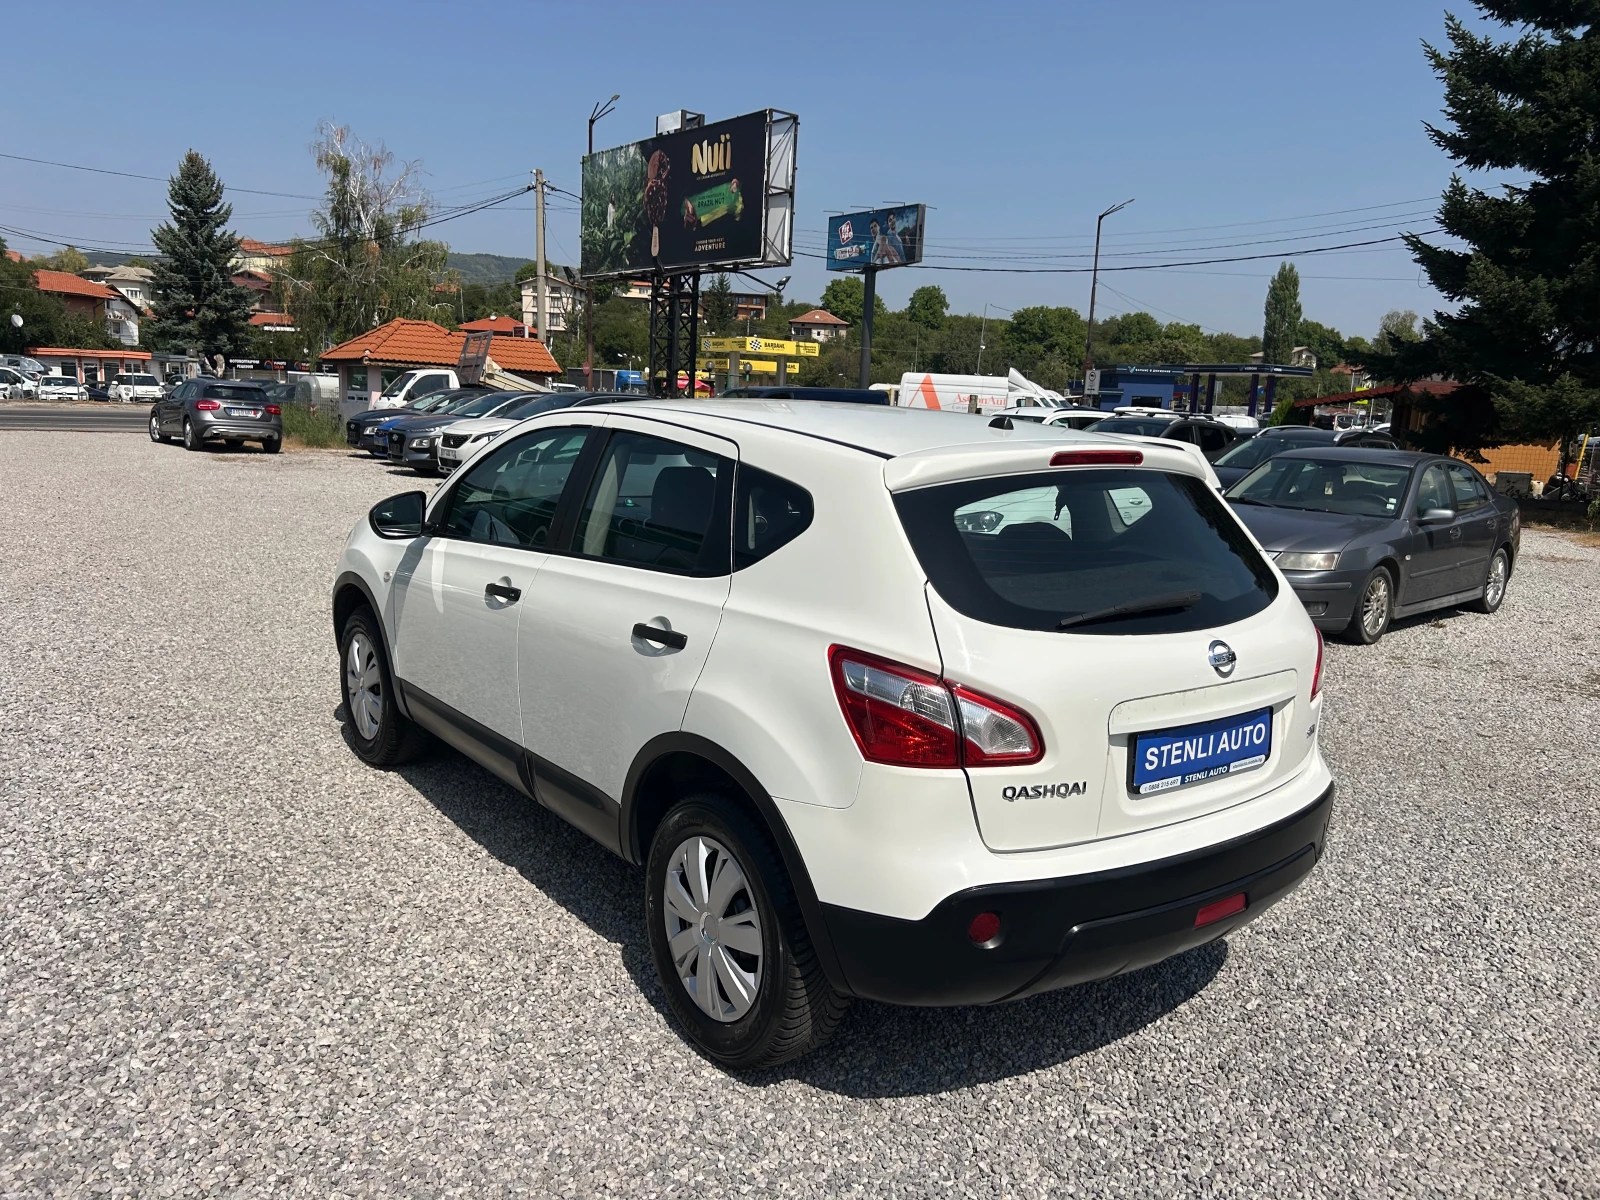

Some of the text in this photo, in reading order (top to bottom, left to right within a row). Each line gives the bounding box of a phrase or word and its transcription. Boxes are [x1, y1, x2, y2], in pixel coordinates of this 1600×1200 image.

[692, 133, 731, 175] Nuii
[694, 242, 726, 252] ADVENTURE
[764, 342, 785, 350] BARDAHL
[1144, 734, 1214, 771] STENLI
[1217, 722, 1266, 754] AUTO
[1184, 765, 1228, 783] STENLI AUTO
[1002, 781, 1087, 802] QASHQAI
